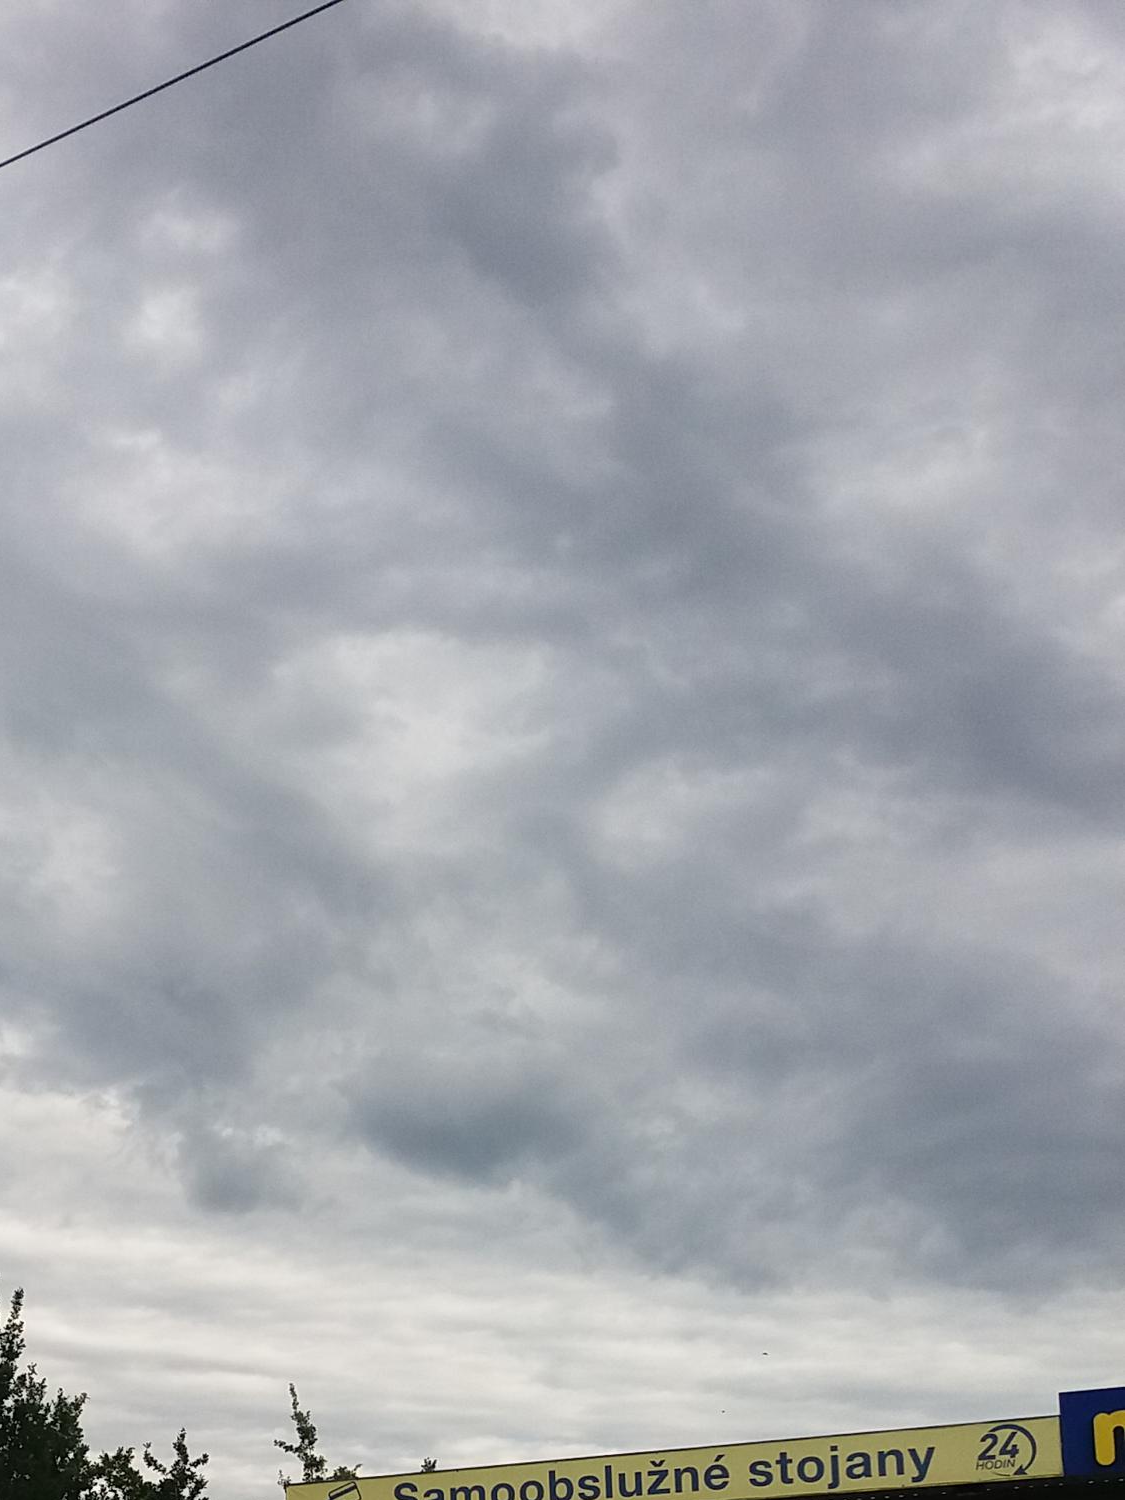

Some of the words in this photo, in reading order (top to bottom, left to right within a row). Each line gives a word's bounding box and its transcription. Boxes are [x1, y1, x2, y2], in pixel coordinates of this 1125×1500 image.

[978, 1431, 1019, 1460] 24
[749, 1445, 936, 1492] stojany
[976, 1459, 1016, 1470] HODIN
